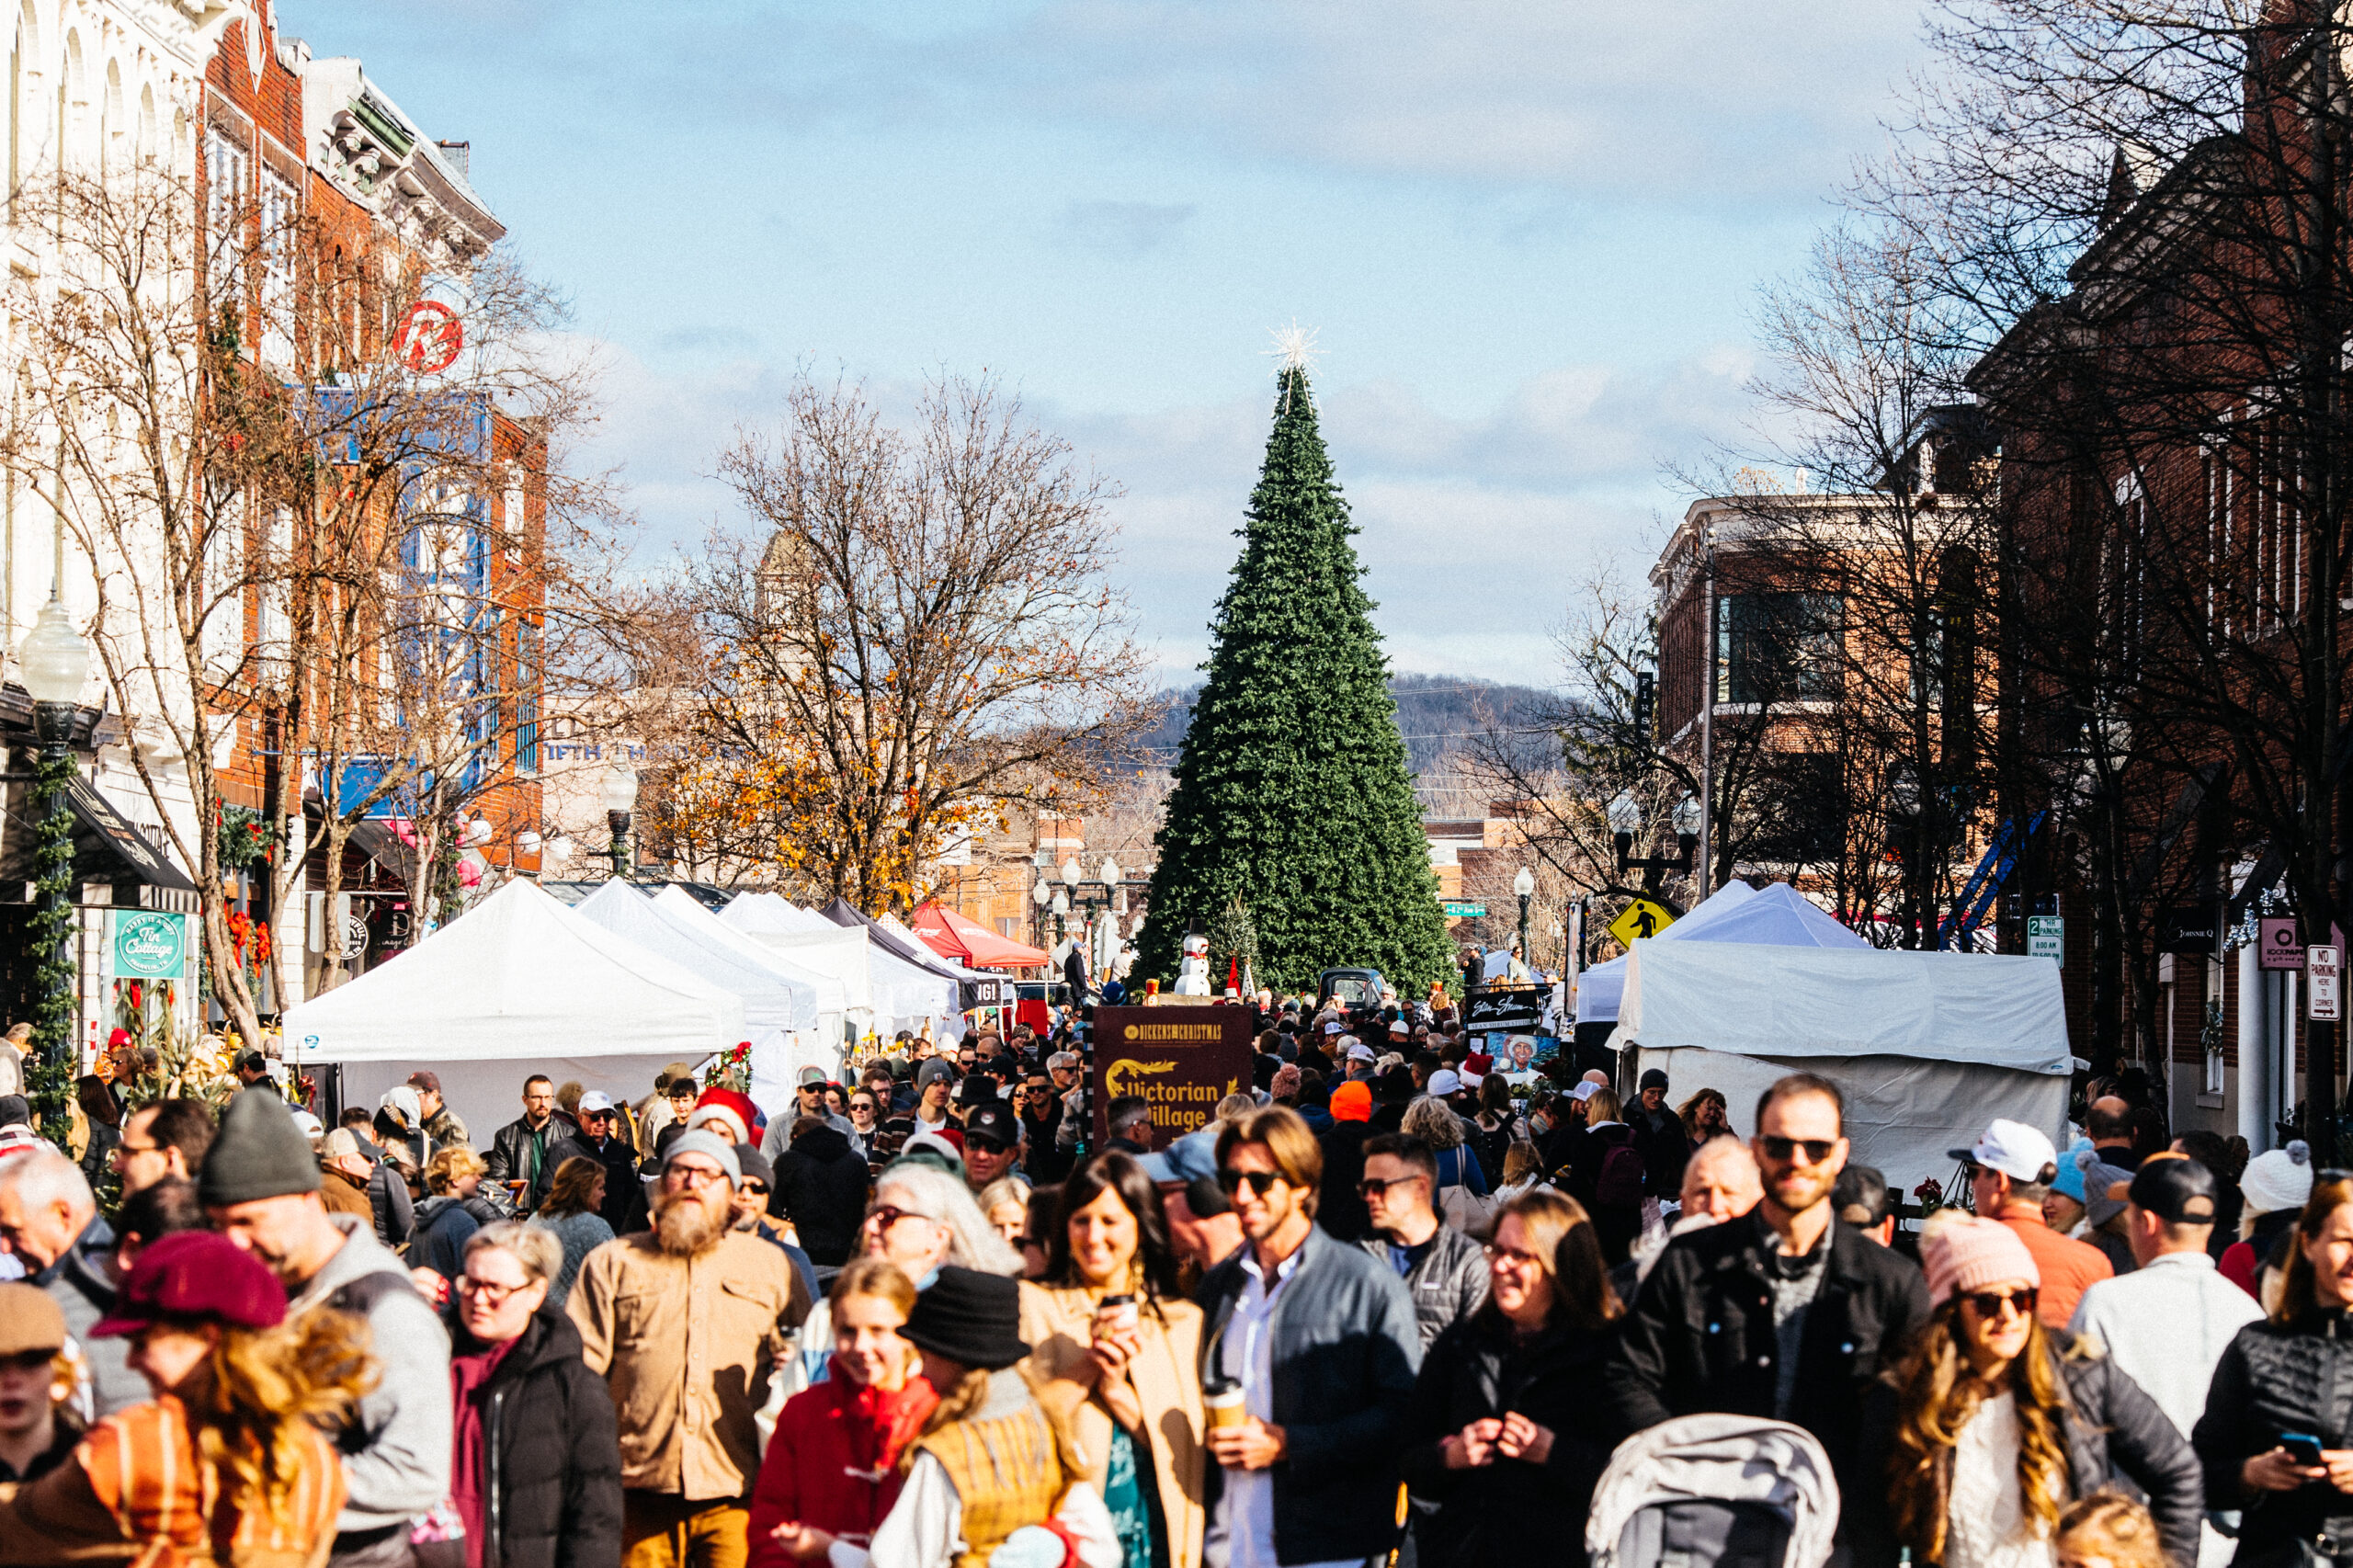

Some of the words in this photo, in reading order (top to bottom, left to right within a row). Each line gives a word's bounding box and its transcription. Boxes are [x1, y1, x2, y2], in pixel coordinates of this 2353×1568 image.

[1641, 678, 1651, 736] FIRST
[543, 743, 600, 760] IFTH
[125, 915, 146, 935] HAPPY
[148, 915, 155, 924] IS
[2030, 920, 2039, 934] 2
[139, 926, 161, 943] Tin
[2207, 928, 2214, 938] Q
[125, 937, 174, 960] Cottage
[2317, 949, 2329, 963] NO
[2312, 963, 2336, 977] PARKING
[2318, 978, 2330, 986] HERE
[2321, 988, 2327, 996] TO
[2315, 998, 2334, 1007] CORNER
[1140, 1024, 1171, 1040] DICKENS
[1178, 1024, 1222, 1040] CHRISTMAS
[1127, 1081, 1219, 1102] Victorian
